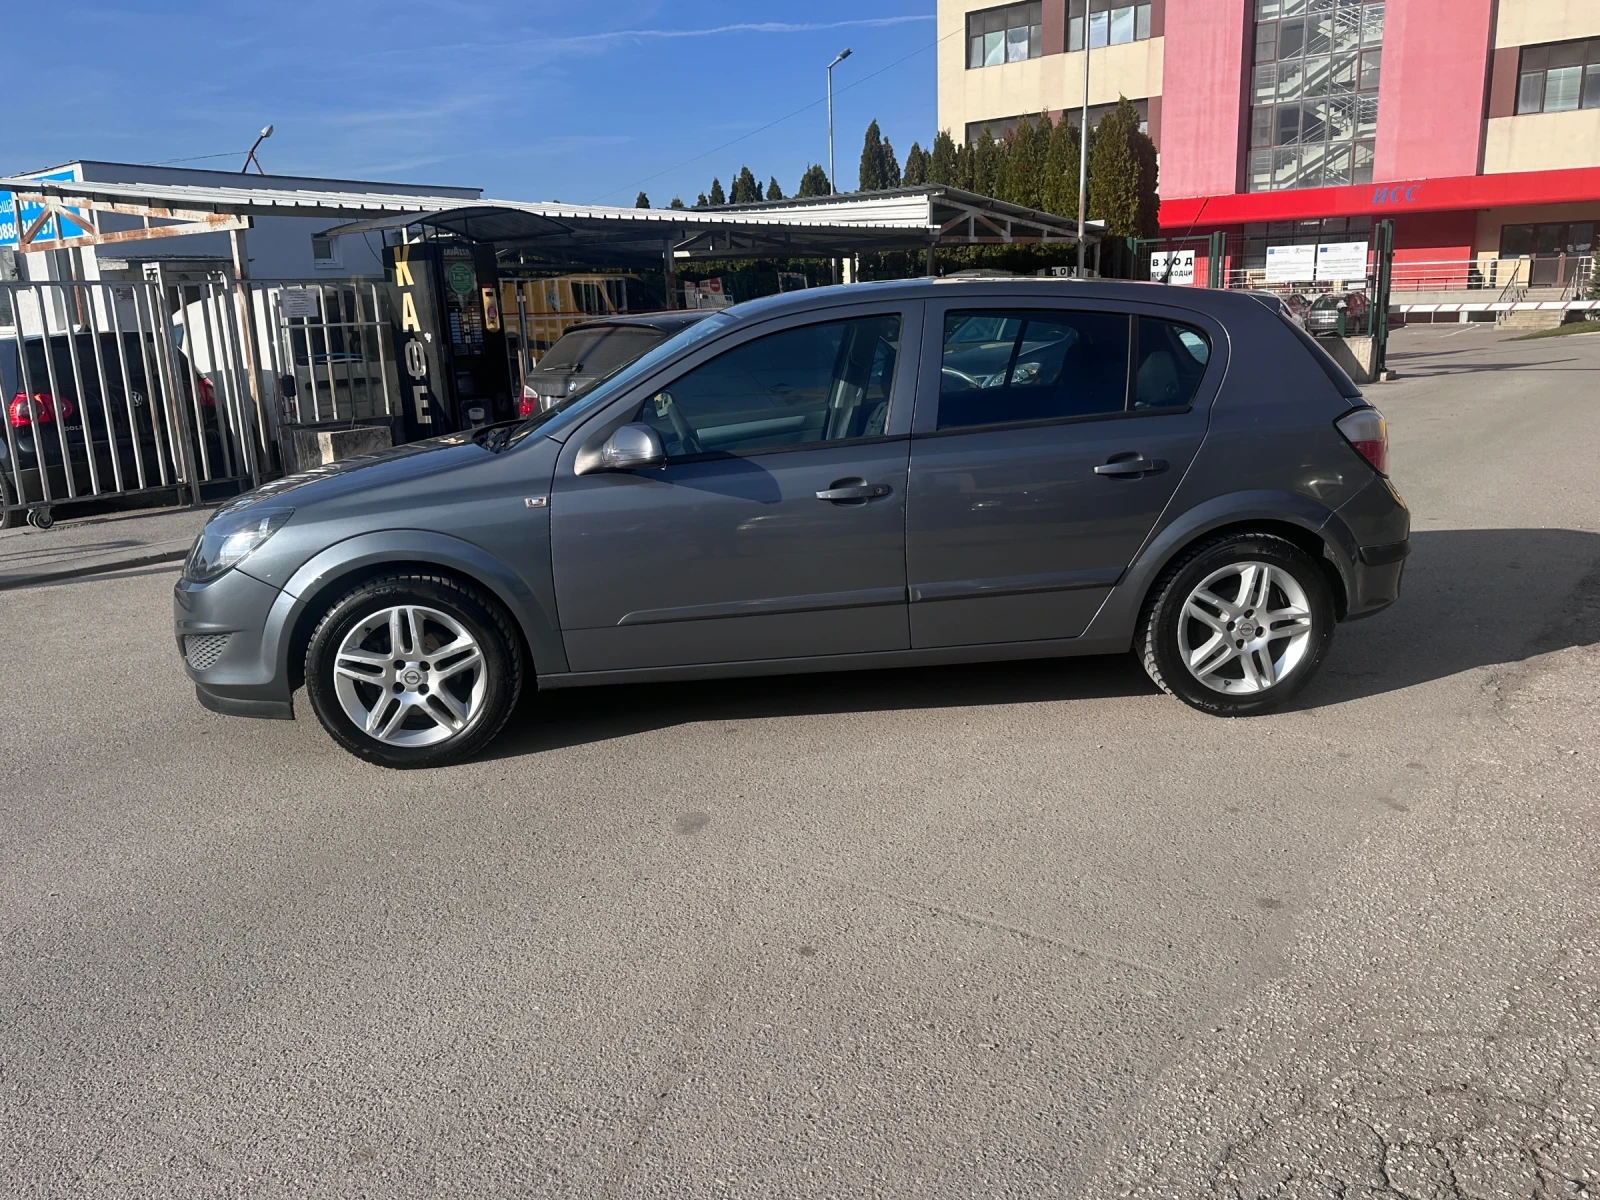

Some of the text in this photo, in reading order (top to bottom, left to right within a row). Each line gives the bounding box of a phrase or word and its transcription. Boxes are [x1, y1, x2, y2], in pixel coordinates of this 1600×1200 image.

[1372, 184, 1423, 205] ИСС
[1152, 257, 1193, 266] ВХОД
[393, 245, 432, 424] КАФЕ
